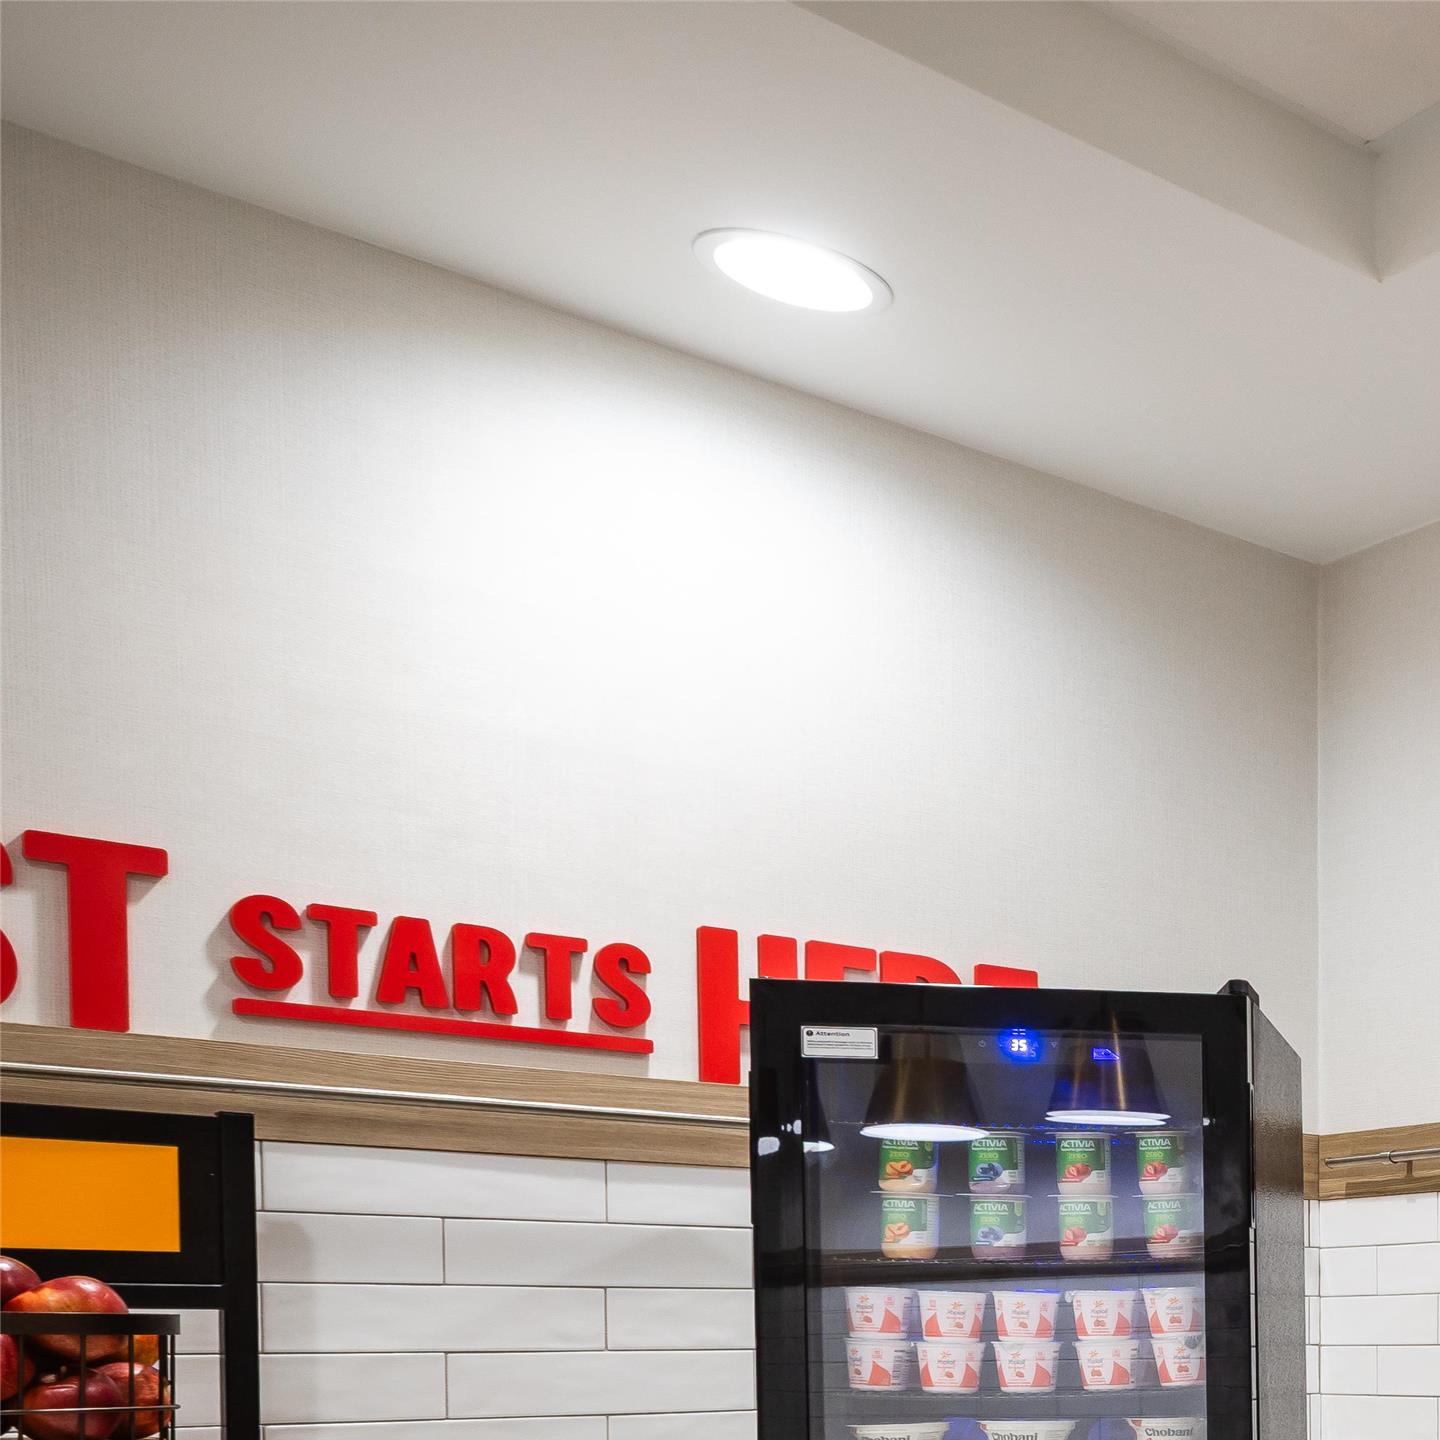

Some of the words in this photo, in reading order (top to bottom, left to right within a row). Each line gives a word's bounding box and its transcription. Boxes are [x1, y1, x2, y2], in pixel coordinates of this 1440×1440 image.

[229, 893, 652, 1028] STARTS
[1011, 1038, 1028, 1052] 35
[1060, 1139, 1095, 1148] ACTIVIA
